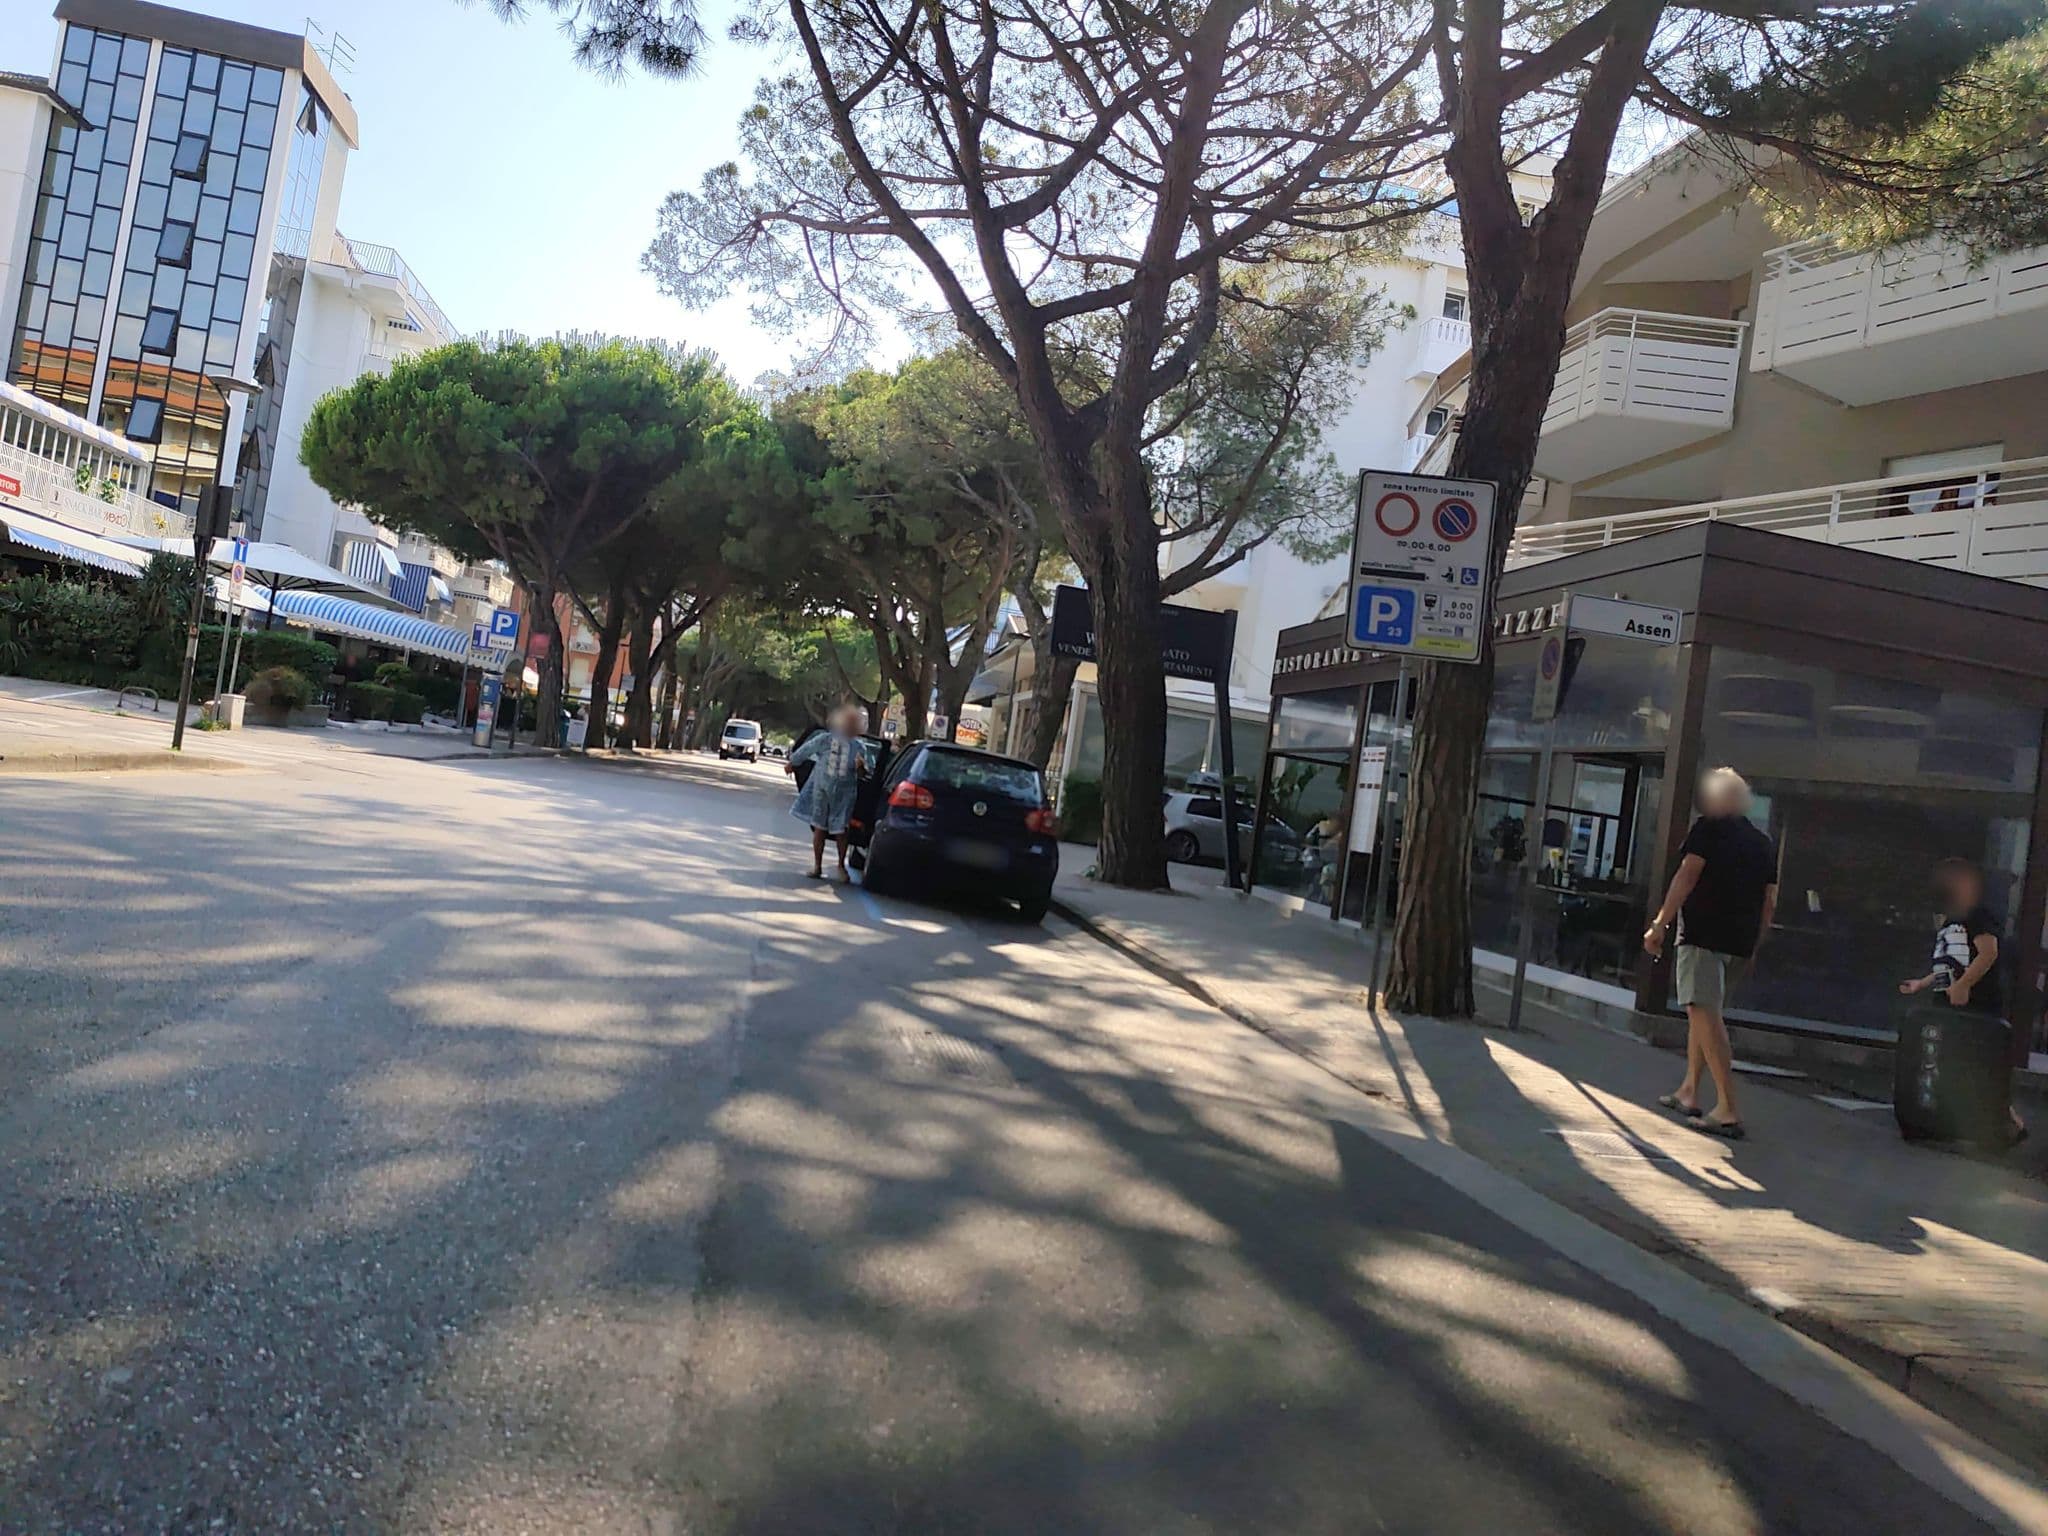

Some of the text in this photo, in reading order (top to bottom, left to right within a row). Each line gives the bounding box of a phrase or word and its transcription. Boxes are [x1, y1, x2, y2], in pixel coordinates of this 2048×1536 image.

[1405, 484, 1438, 494] traffico
[1440, 487, 1475, 498] limitato
[495, 614, 513, 633] P
[1368, 594, 1400, 634] P
[1387, 626, 1402, 637] 23
[1625, 619, 1671, 639] Assen
[1057, 642, 1092, 657] VENDE
[1274, 647, 1361, 675] RISTORANTE
